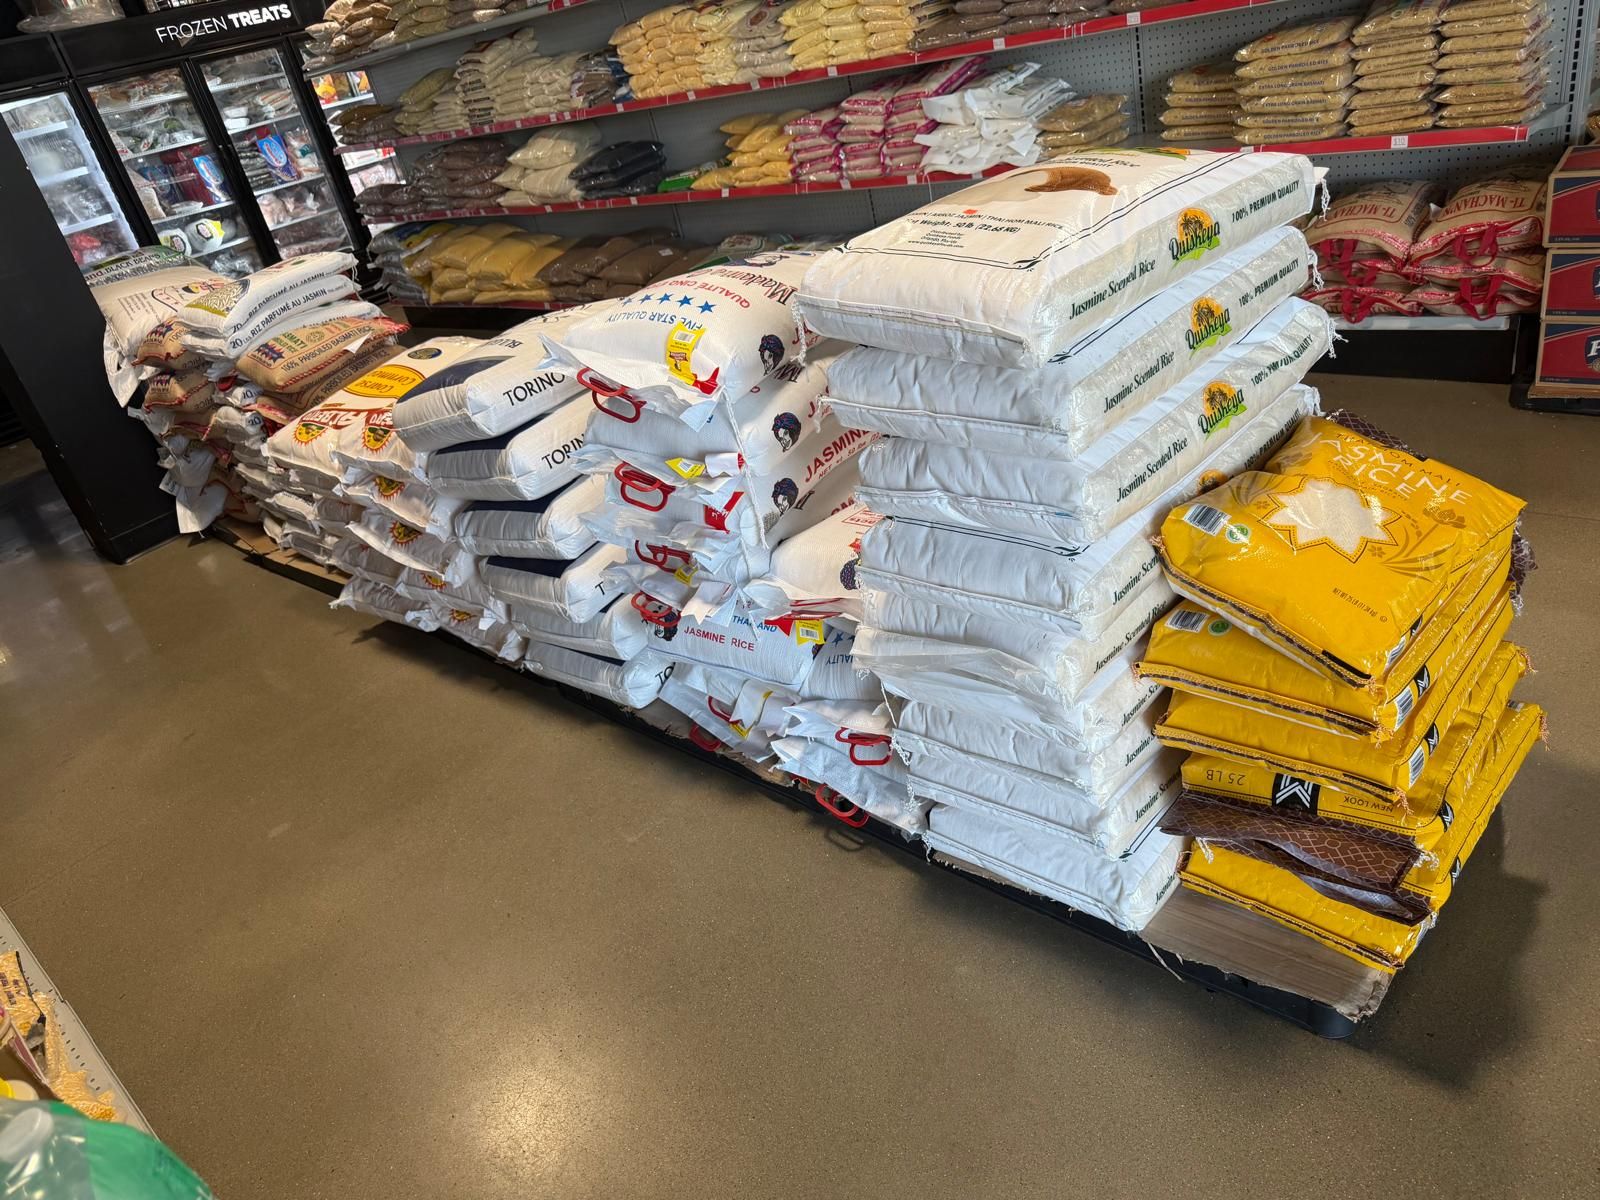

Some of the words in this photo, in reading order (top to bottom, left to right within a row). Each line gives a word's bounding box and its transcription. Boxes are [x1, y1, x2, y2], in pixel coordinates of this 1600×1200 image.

[155, 16, 228, 43] FROZEN
[227, 3, 292, 28] TREATS
[1231, 206, 1249, 224] 100%
[1249, 191, 1278, 215] PREMIUM
[1277, 179, 1300, 199] QUALITY
[695, 281, 751, 309] QUALITÉ
[711, 268, 800, 306] Madame
[1069, 288, 1108, 320] Jasmine
[1133, 257, 1156, 279] Rice
[1238, 290, 1254, 308] 100%
[1254, 274, 1280, 298] PREMIUM
[1278, 257, 1300, 280] QUALITY
[230, 337, 243, 350] 20
[250, 324, 262, 337] RIZ
[261, 299, 292, 329] PARFUMÉ
[291, 297, 302, 309] AU
[301, 286, 328, 304] JASMIN
[605, 310, 648, 324] QUALITY
[648, 311, 677, 325] STAR
[281, 358, 300, 373] 100%
[299, 341, 333, 366] PARBOILED
[332, 328, 358, 350] BASMATI
[354, 380, 394, 395] Coarse
[367, 370, 416, 387] Cornme
[502, 371, 566, 407] TORINO
[1103, 381, 1134, 414] Jasmine
[1132, 358, 1161, 391] Scented
[1159, 350, 1175, 372] Rice
[1250, 367, 1270, 388] 100%
[541, 433, 585, 470] TORIN
[818, 463, 833, 480] NET
[1116, 469, 1148, 503] Jasmine
[1146, 447, 1174, 479] Scented
[1171, 436, 1189, 457] Rice
[1333, 454, 1417, 500] RICE
[1112, 570, 1142, 606] Jasmine
[1141, 555, 1160, 577] Scen
[684, 625, 727, 644] JASMINE
[730, 637, 755, 652] RICE
[1093, 639, 1125, 675] Jasmine
[1124, 613, 1151, 645] Scented
[1149, 599, 1168, 622] Rice
[826, 649, 854, 665] ALITY
[1121, 691, 1148, 727] Jasmine
[1124, 735, 1151, 768] Jasmine
[1206, 769, 1223, 783] LB
[1228, 773, 1247, 787] 25
[1135, 789, 1160, 824] Jasmine
[1343, 794, 1371, 807] LOOK
[1154, 871, 1176, 906] Jasmine
